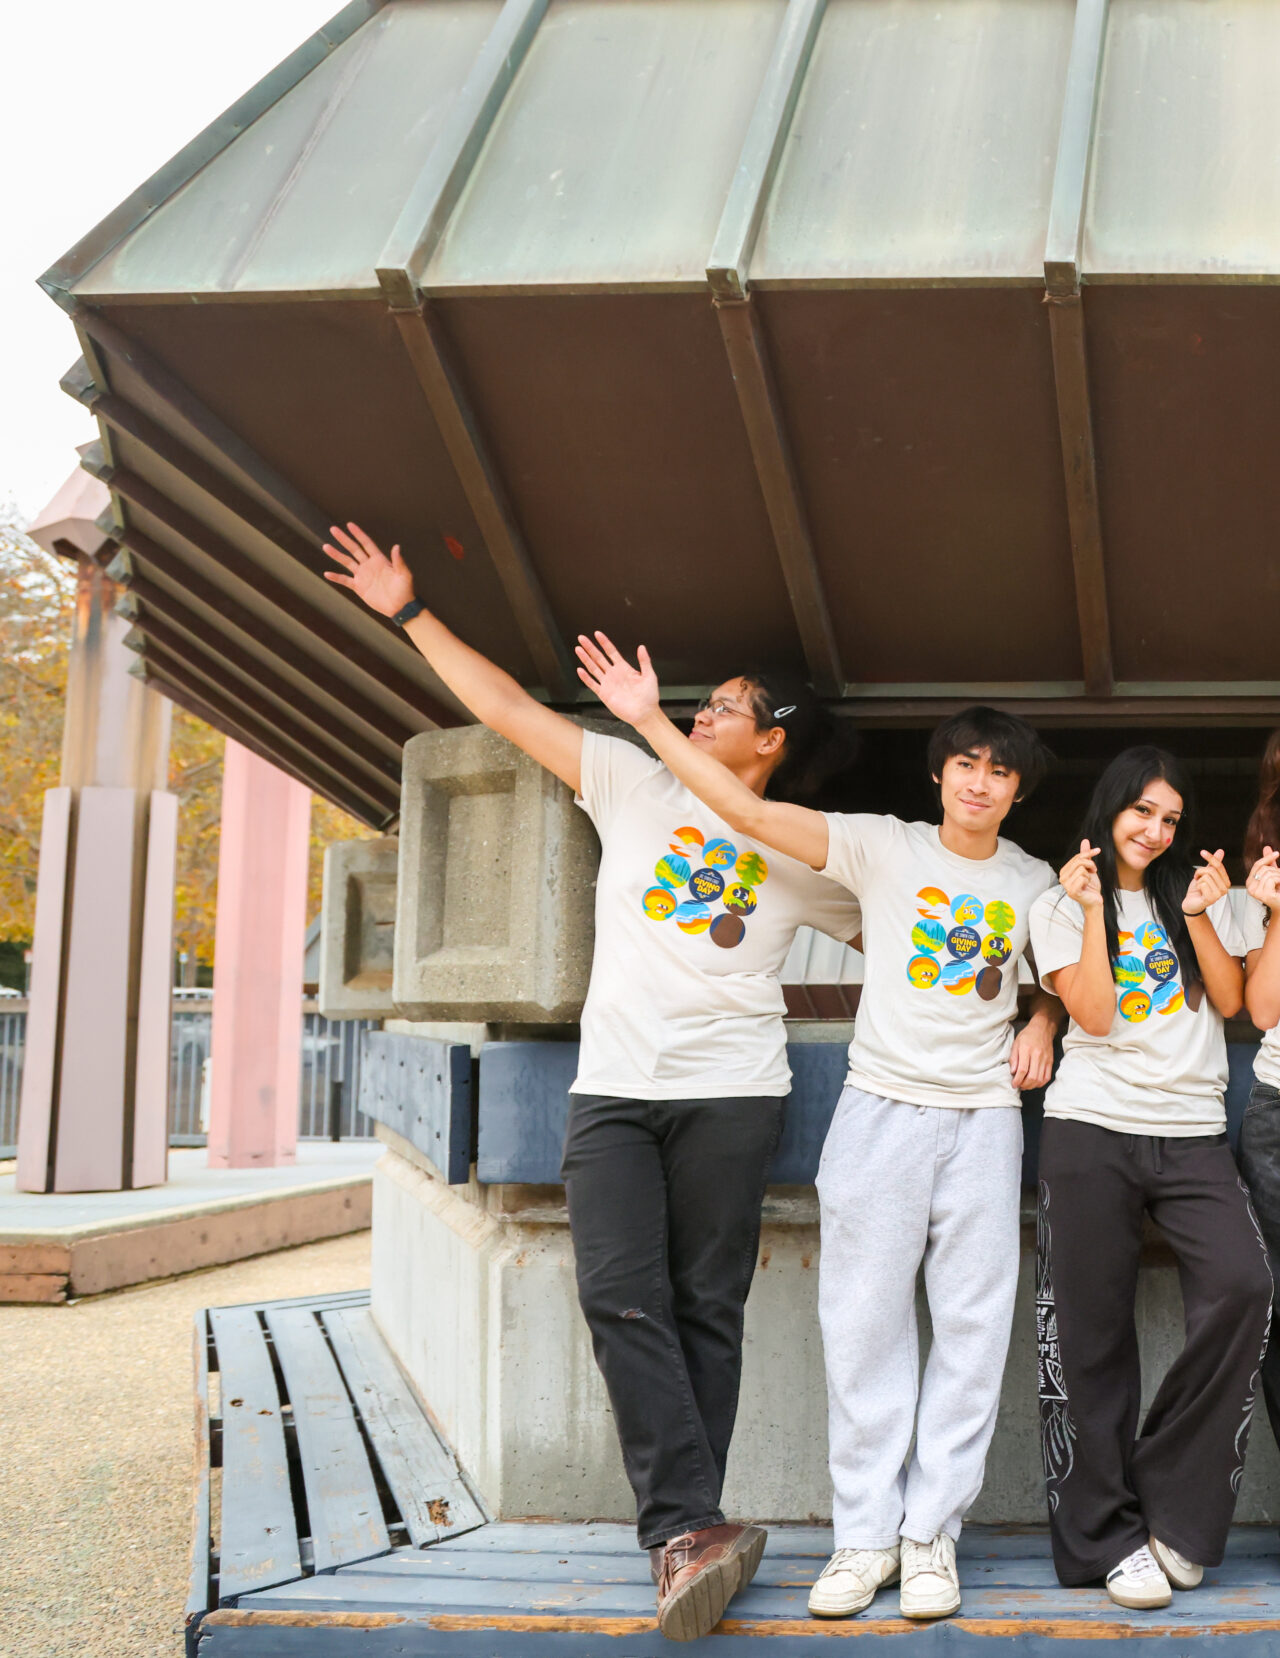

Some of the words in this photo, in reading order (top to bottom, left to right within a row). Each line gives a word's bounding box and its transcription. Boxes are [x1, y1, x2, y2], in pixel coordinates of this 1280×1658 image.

[694, 878, 720, 892] GIVING
[697, 885, 713, 895] DAY
[951, 937, 977, 947] GIVING
[955, 944, 971, 952] DAY
[1149, 959, 1174, 969] GIVING
[1156, 965, 1170, 974] DAY
